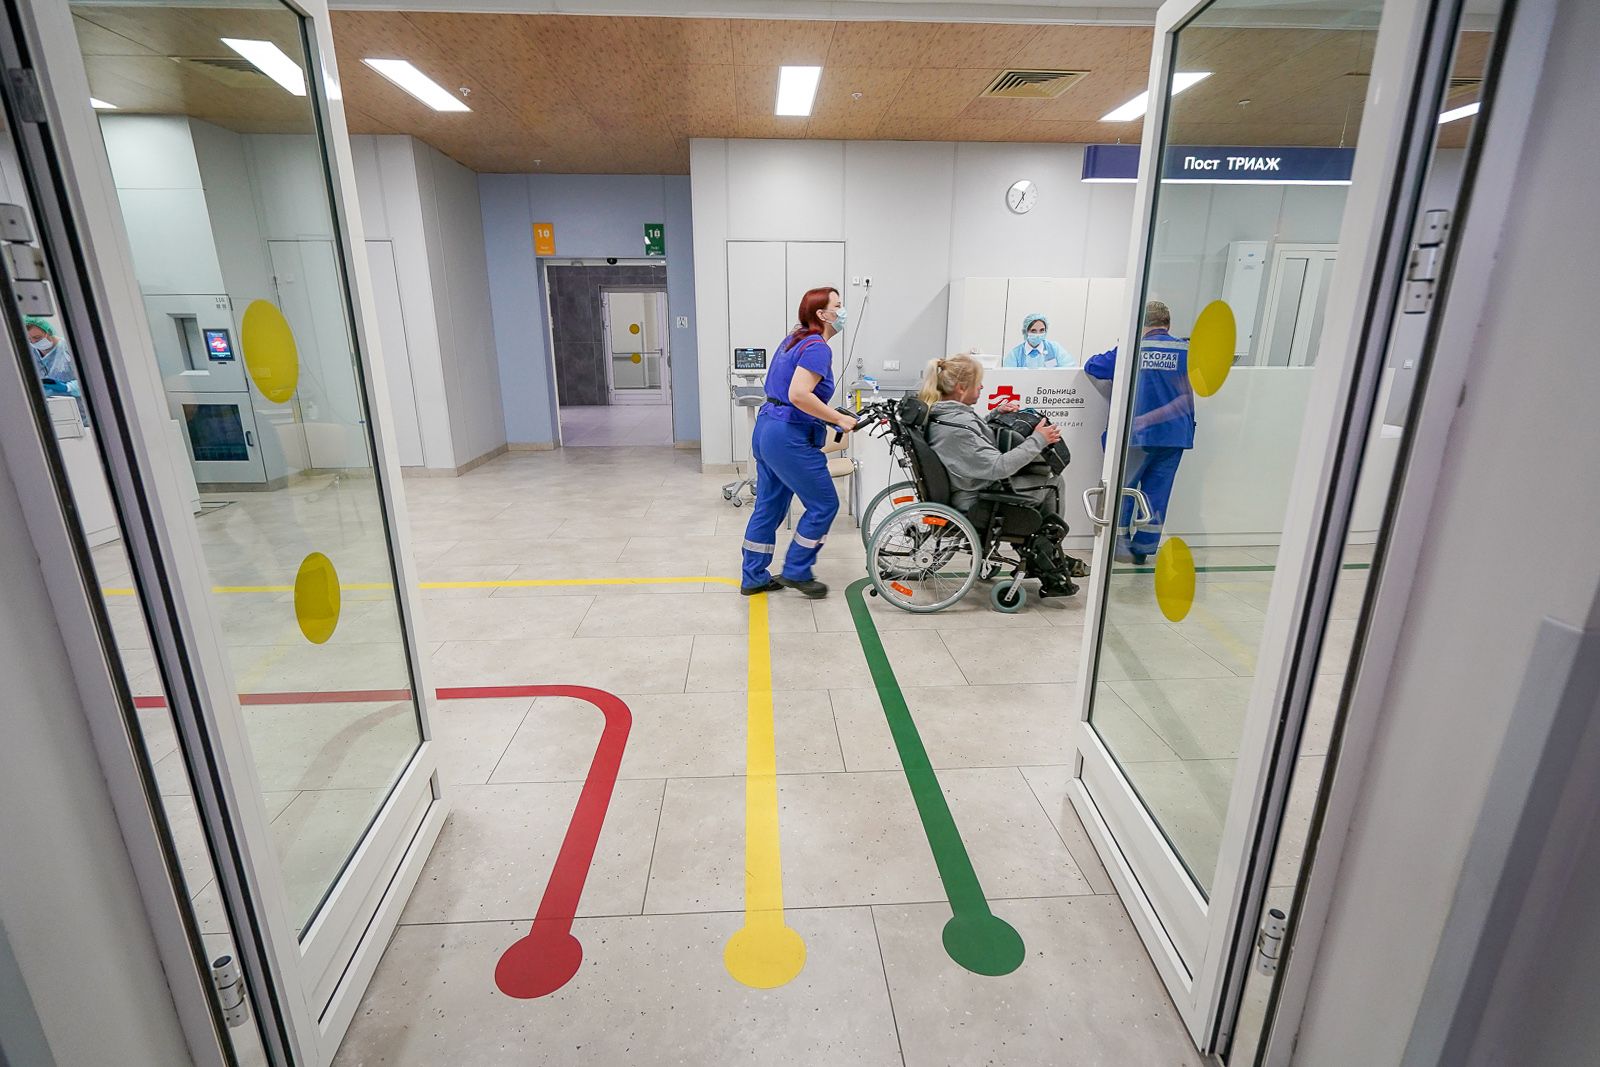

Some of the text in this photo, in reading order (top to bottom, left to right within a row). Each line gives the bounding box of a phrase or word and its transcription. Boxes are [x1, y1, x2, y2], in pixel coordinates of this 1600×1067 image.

[1184, 156, 1281, 171] Пост ТРИАЖ
[1143, 353, 1177, 361] СКОРАЯ
[1142, 360, 1176, 368] ПОМОЩЬ
[1036, 387, 1076, 396] Больница
[1042, 396, 1085, 406] Вересаева
